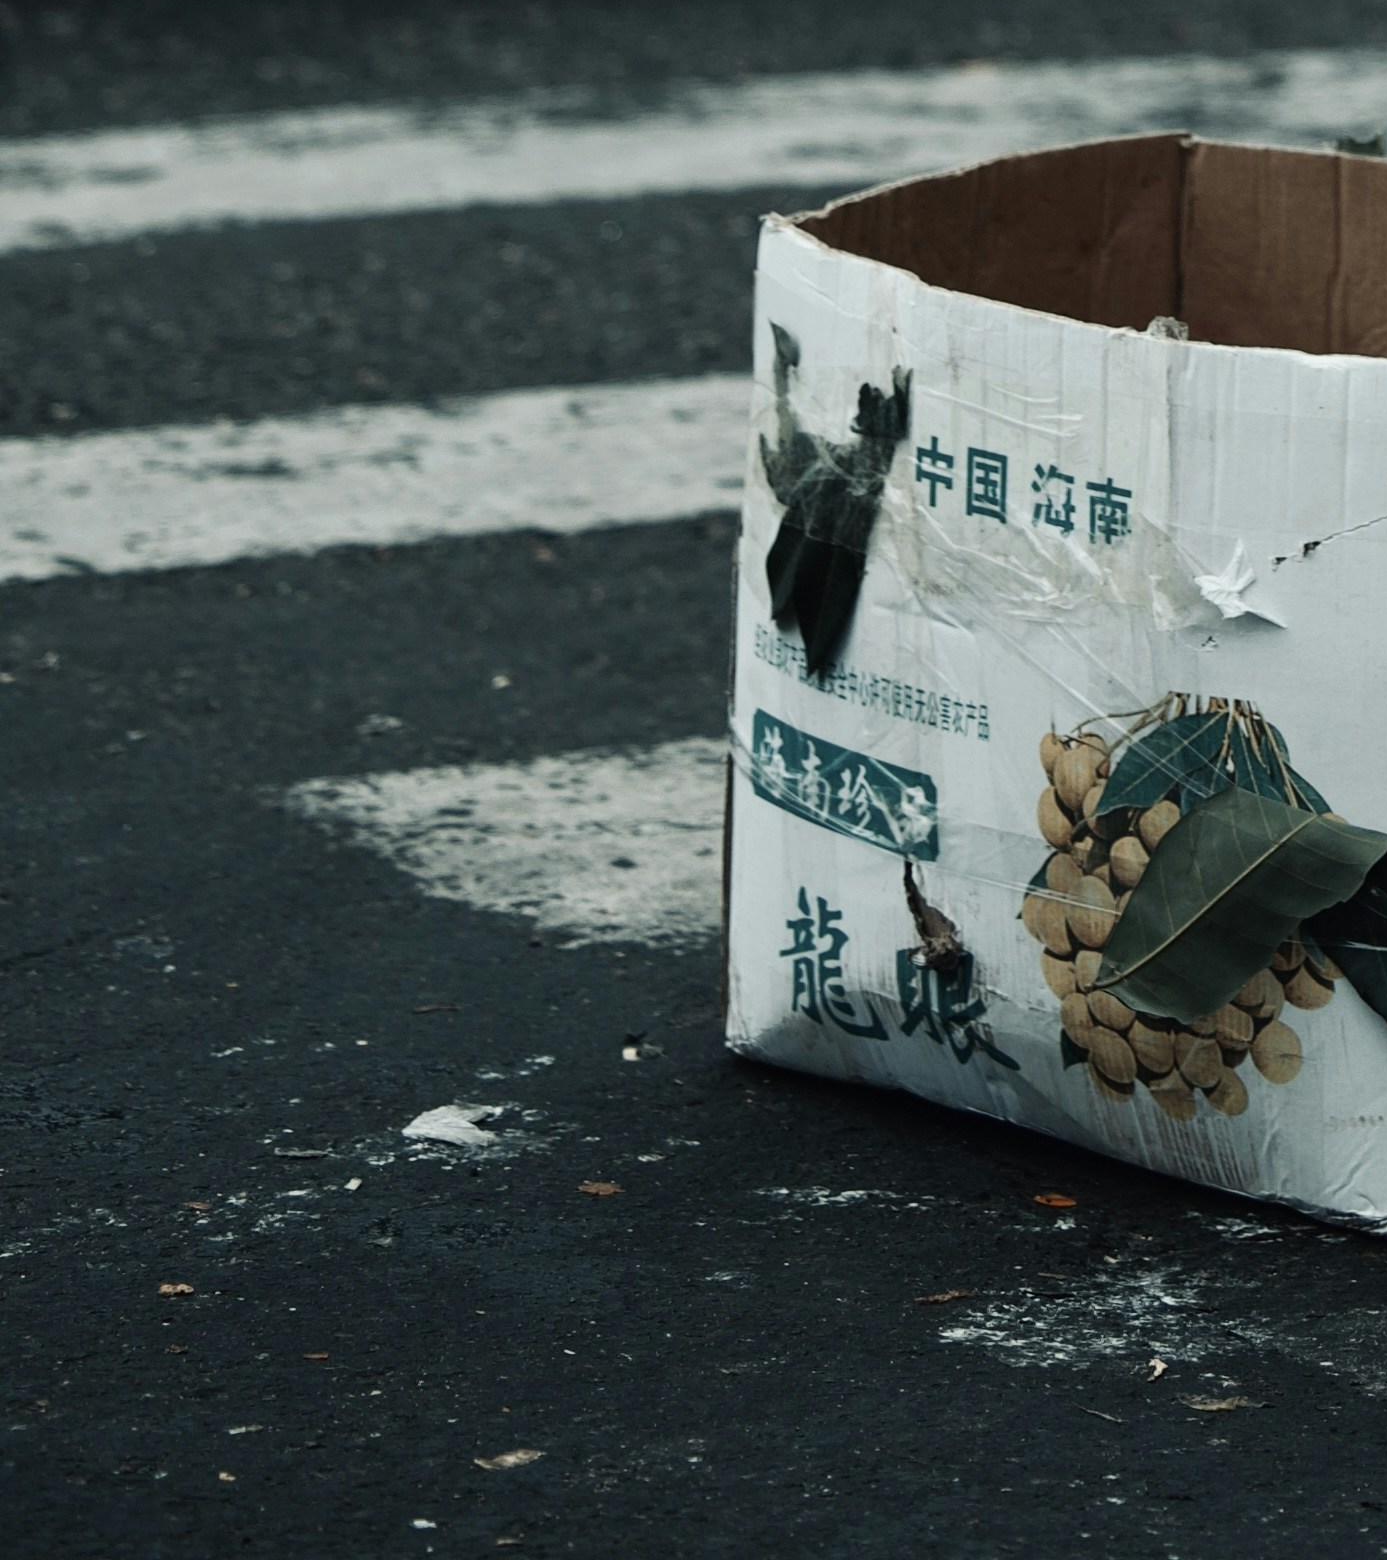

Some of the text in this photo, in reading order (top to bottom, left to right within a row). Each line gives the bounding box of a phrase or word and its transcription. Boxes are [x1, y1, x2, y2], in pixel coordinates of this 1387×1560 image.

[915, 435, 1133, 545] 中国 海南
[778, 885, 1021, 1071] 龍眼
